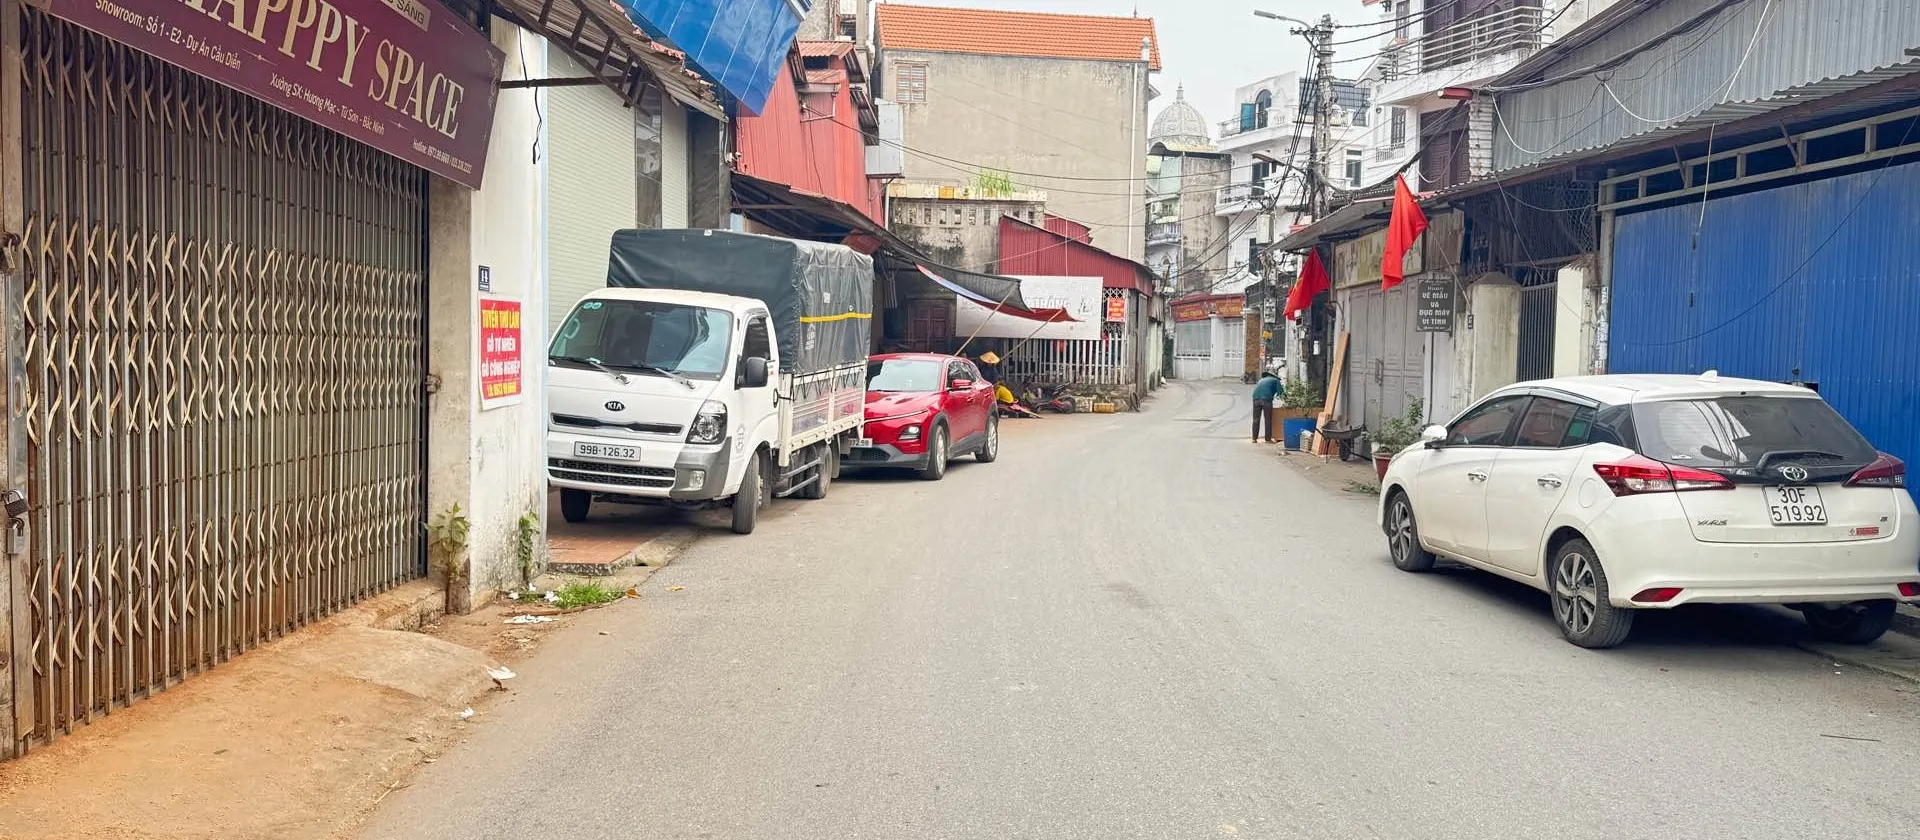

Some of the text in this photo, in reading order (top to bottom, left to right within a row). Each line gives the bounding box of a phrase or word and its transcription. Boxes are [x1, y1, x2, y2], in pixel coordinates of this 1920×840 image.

[95, 0, 145, 29] Showroom:
[146, 15, 158, 34] Số
[160, 22, 165, 37] 1
[170, 27, 182, 44] E2
[186, 34, 198, 55] Dự
[368, 39, 464, 139] SPACE
[607, 402, 622, 410] KIA
[1778, 487, 1806, 504] 30F
[1771, 505, 1823, 522] 519.92
